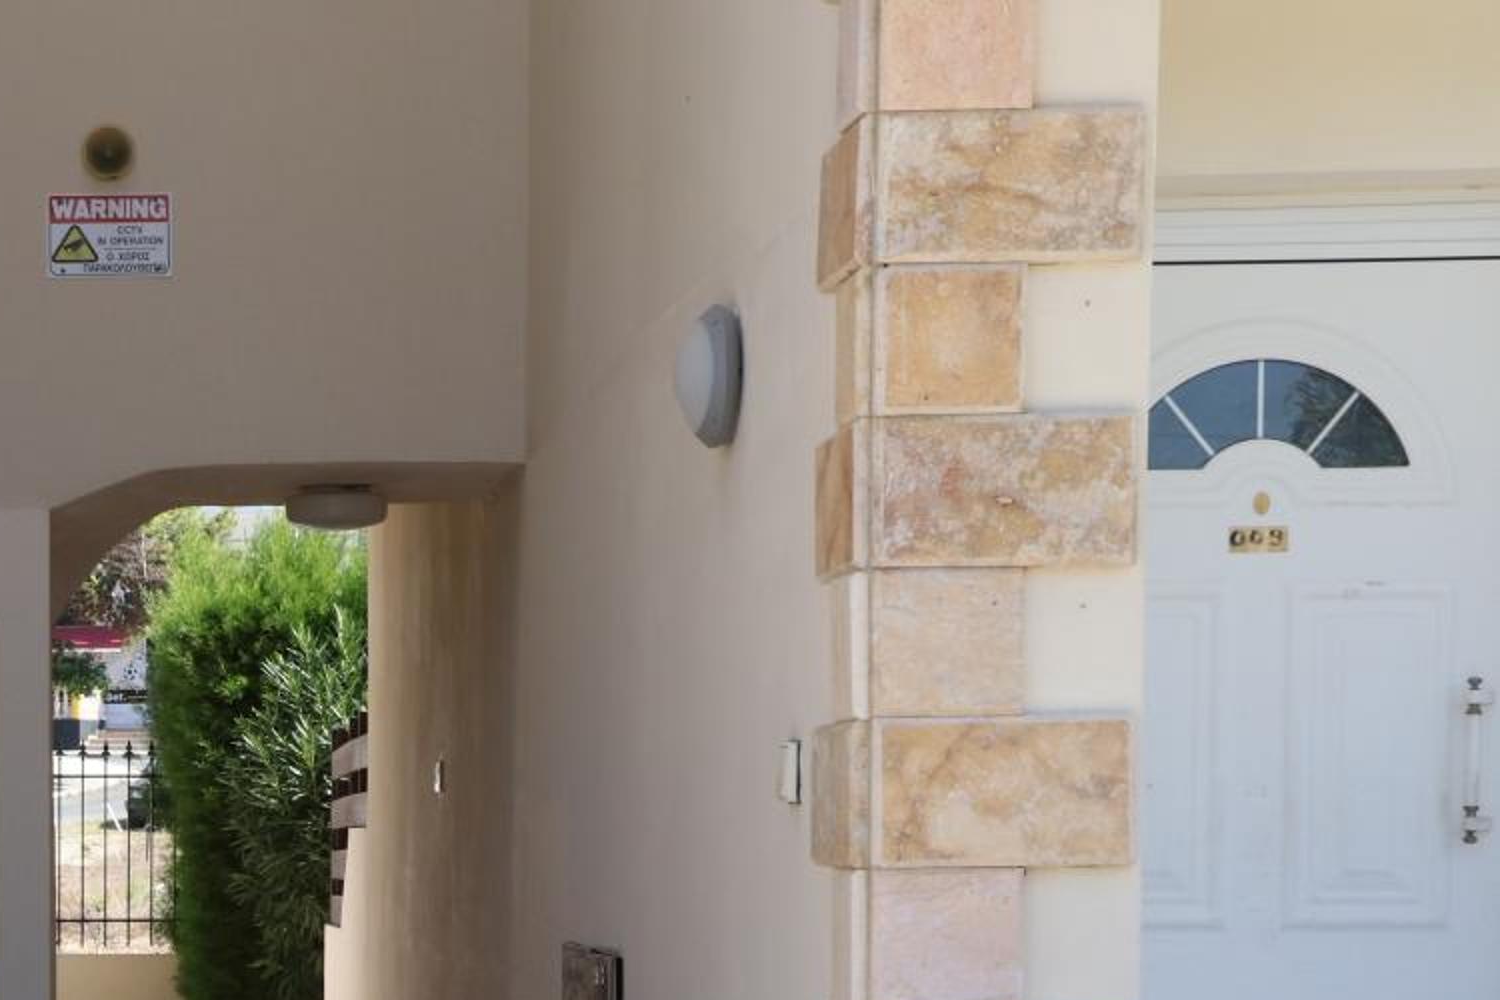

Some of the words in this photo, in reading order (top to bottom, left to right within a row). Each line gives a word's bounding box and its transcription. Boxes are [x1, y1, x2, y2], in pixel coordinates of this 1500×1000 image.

[51, 198, 167, 219] WARNING
[116, 225, 143, 234] CCTV
[97, 236, 107, 245] IN
[109, 236, 163, 245] OPERATION
